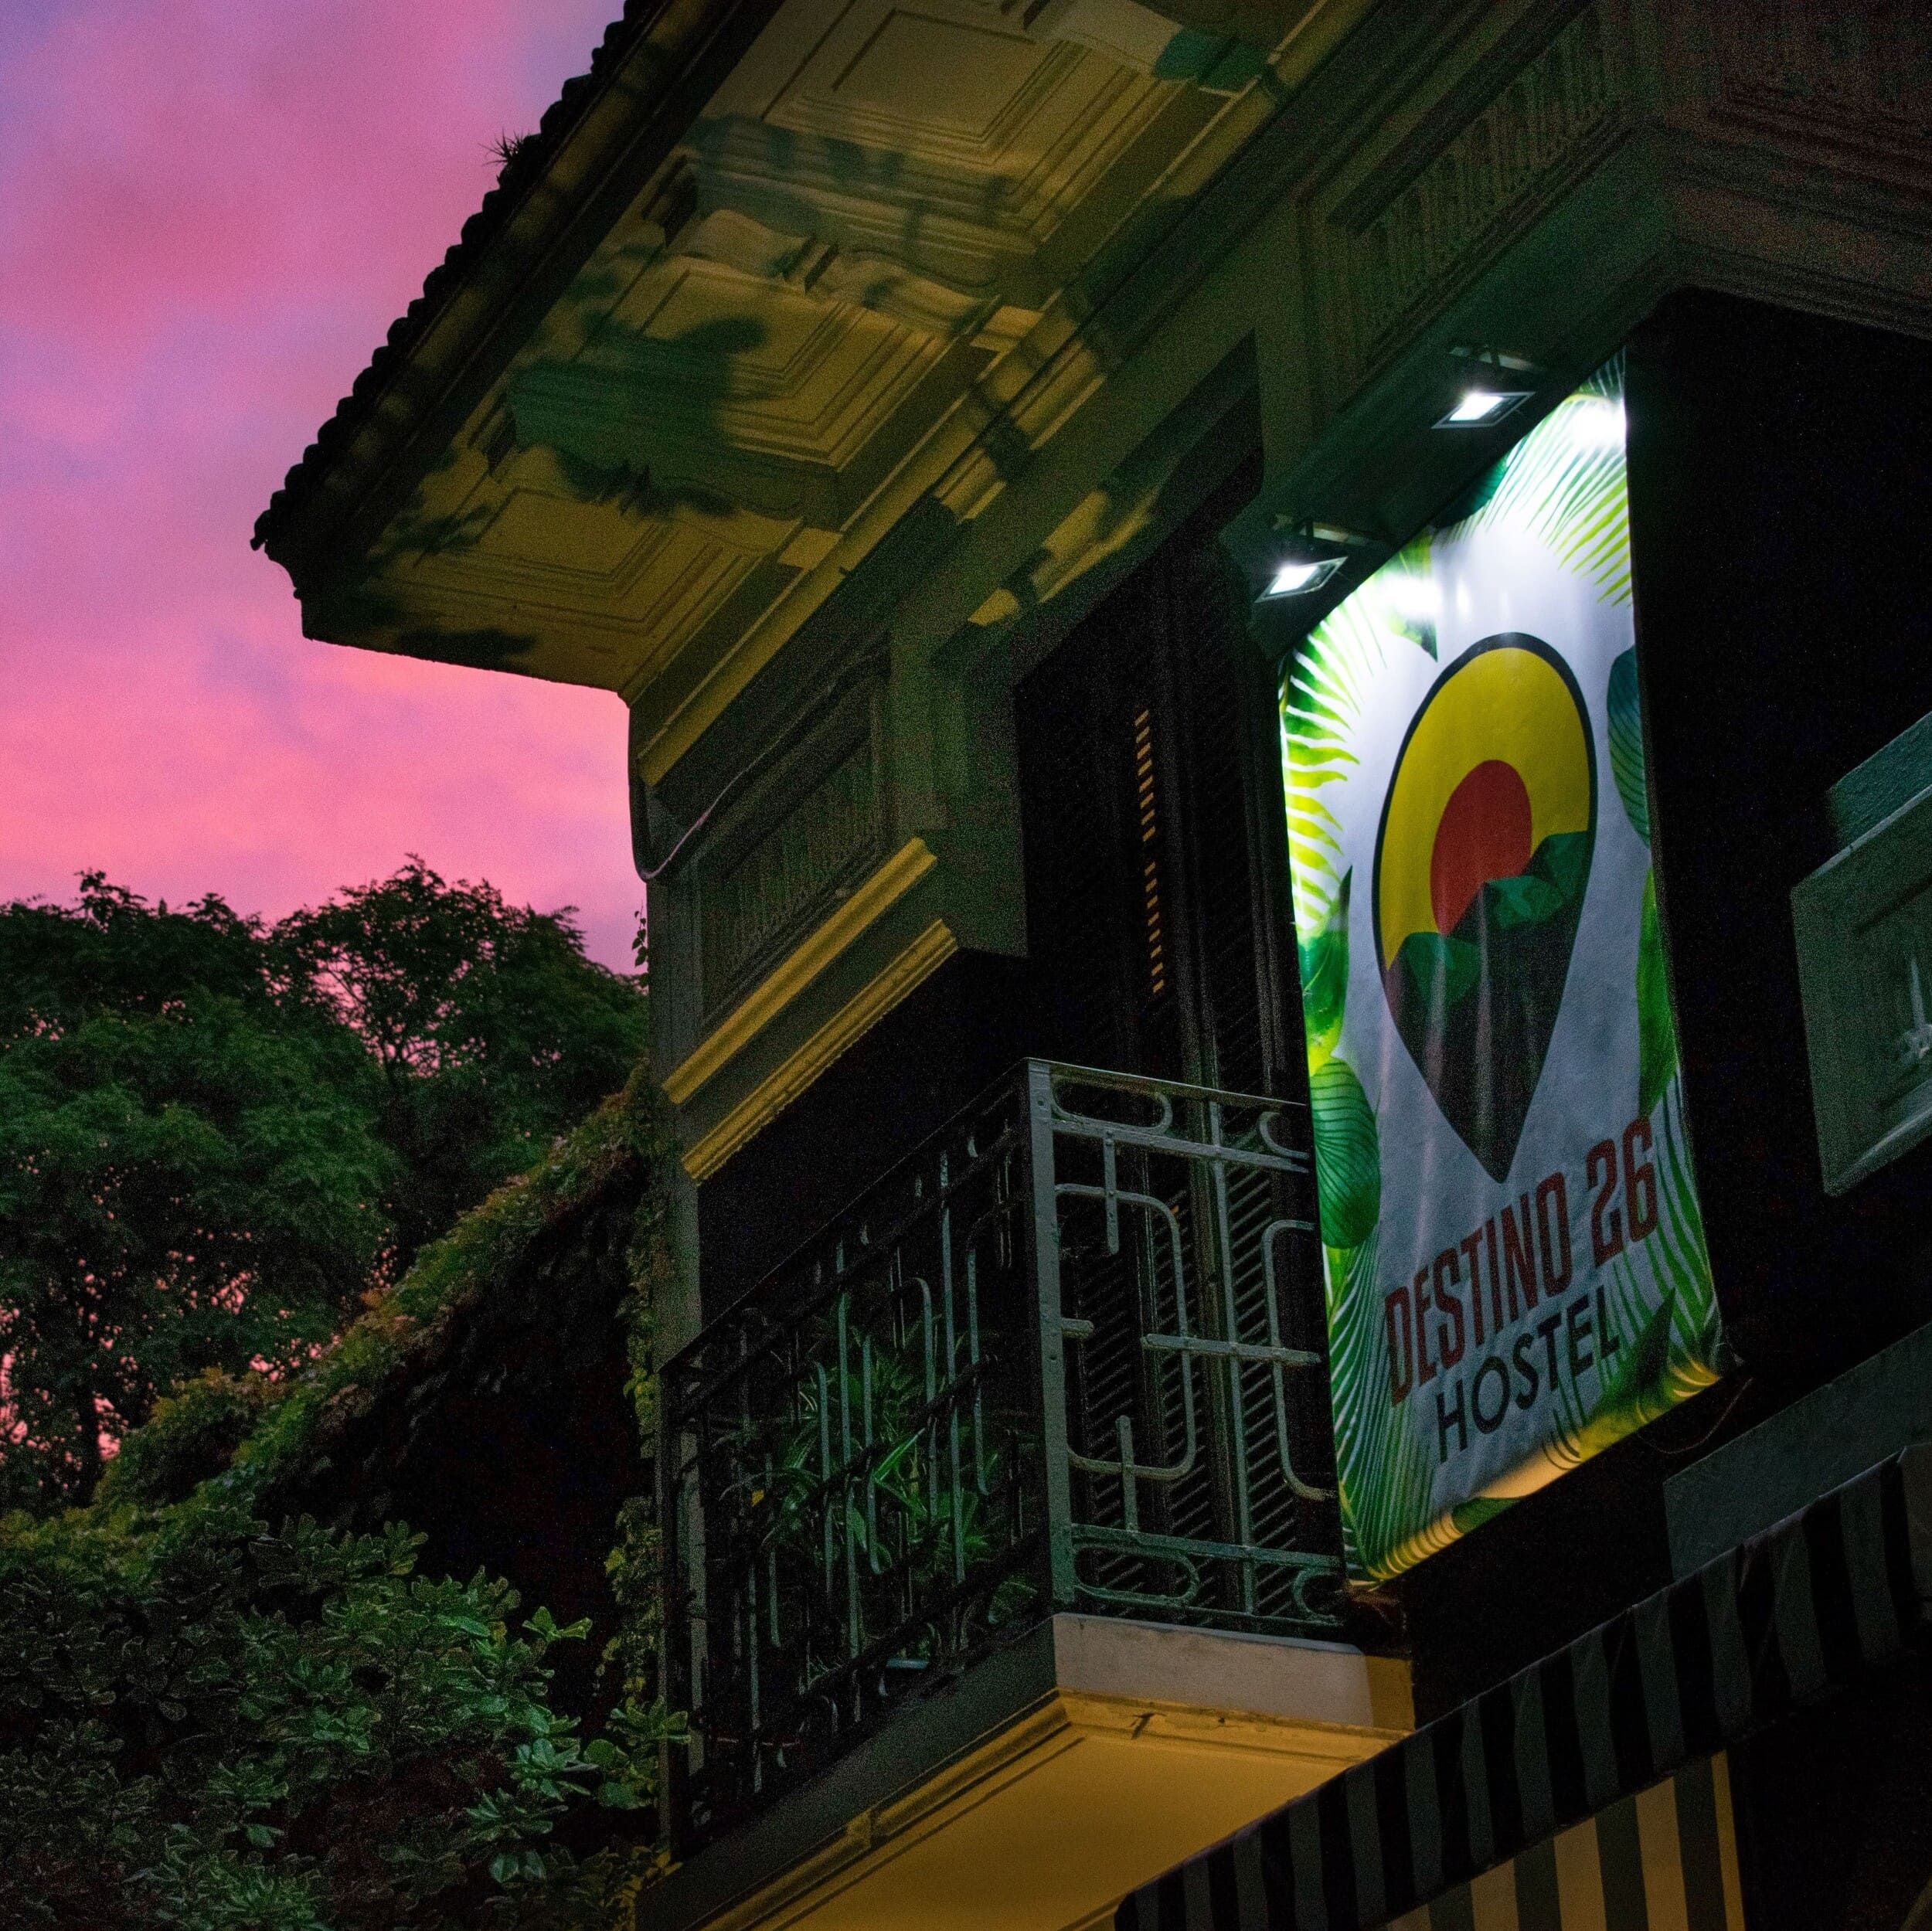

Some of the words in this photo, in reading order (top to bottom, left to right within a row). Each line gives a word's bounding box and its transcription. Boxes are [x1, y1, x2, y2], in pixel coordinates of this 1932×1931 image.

[1384, 1171, 1573, 1406] DESTINO
[1587, 1117, 1658, 1268] 26
[1435, 1285, 1620, 1464] HOSTEL
